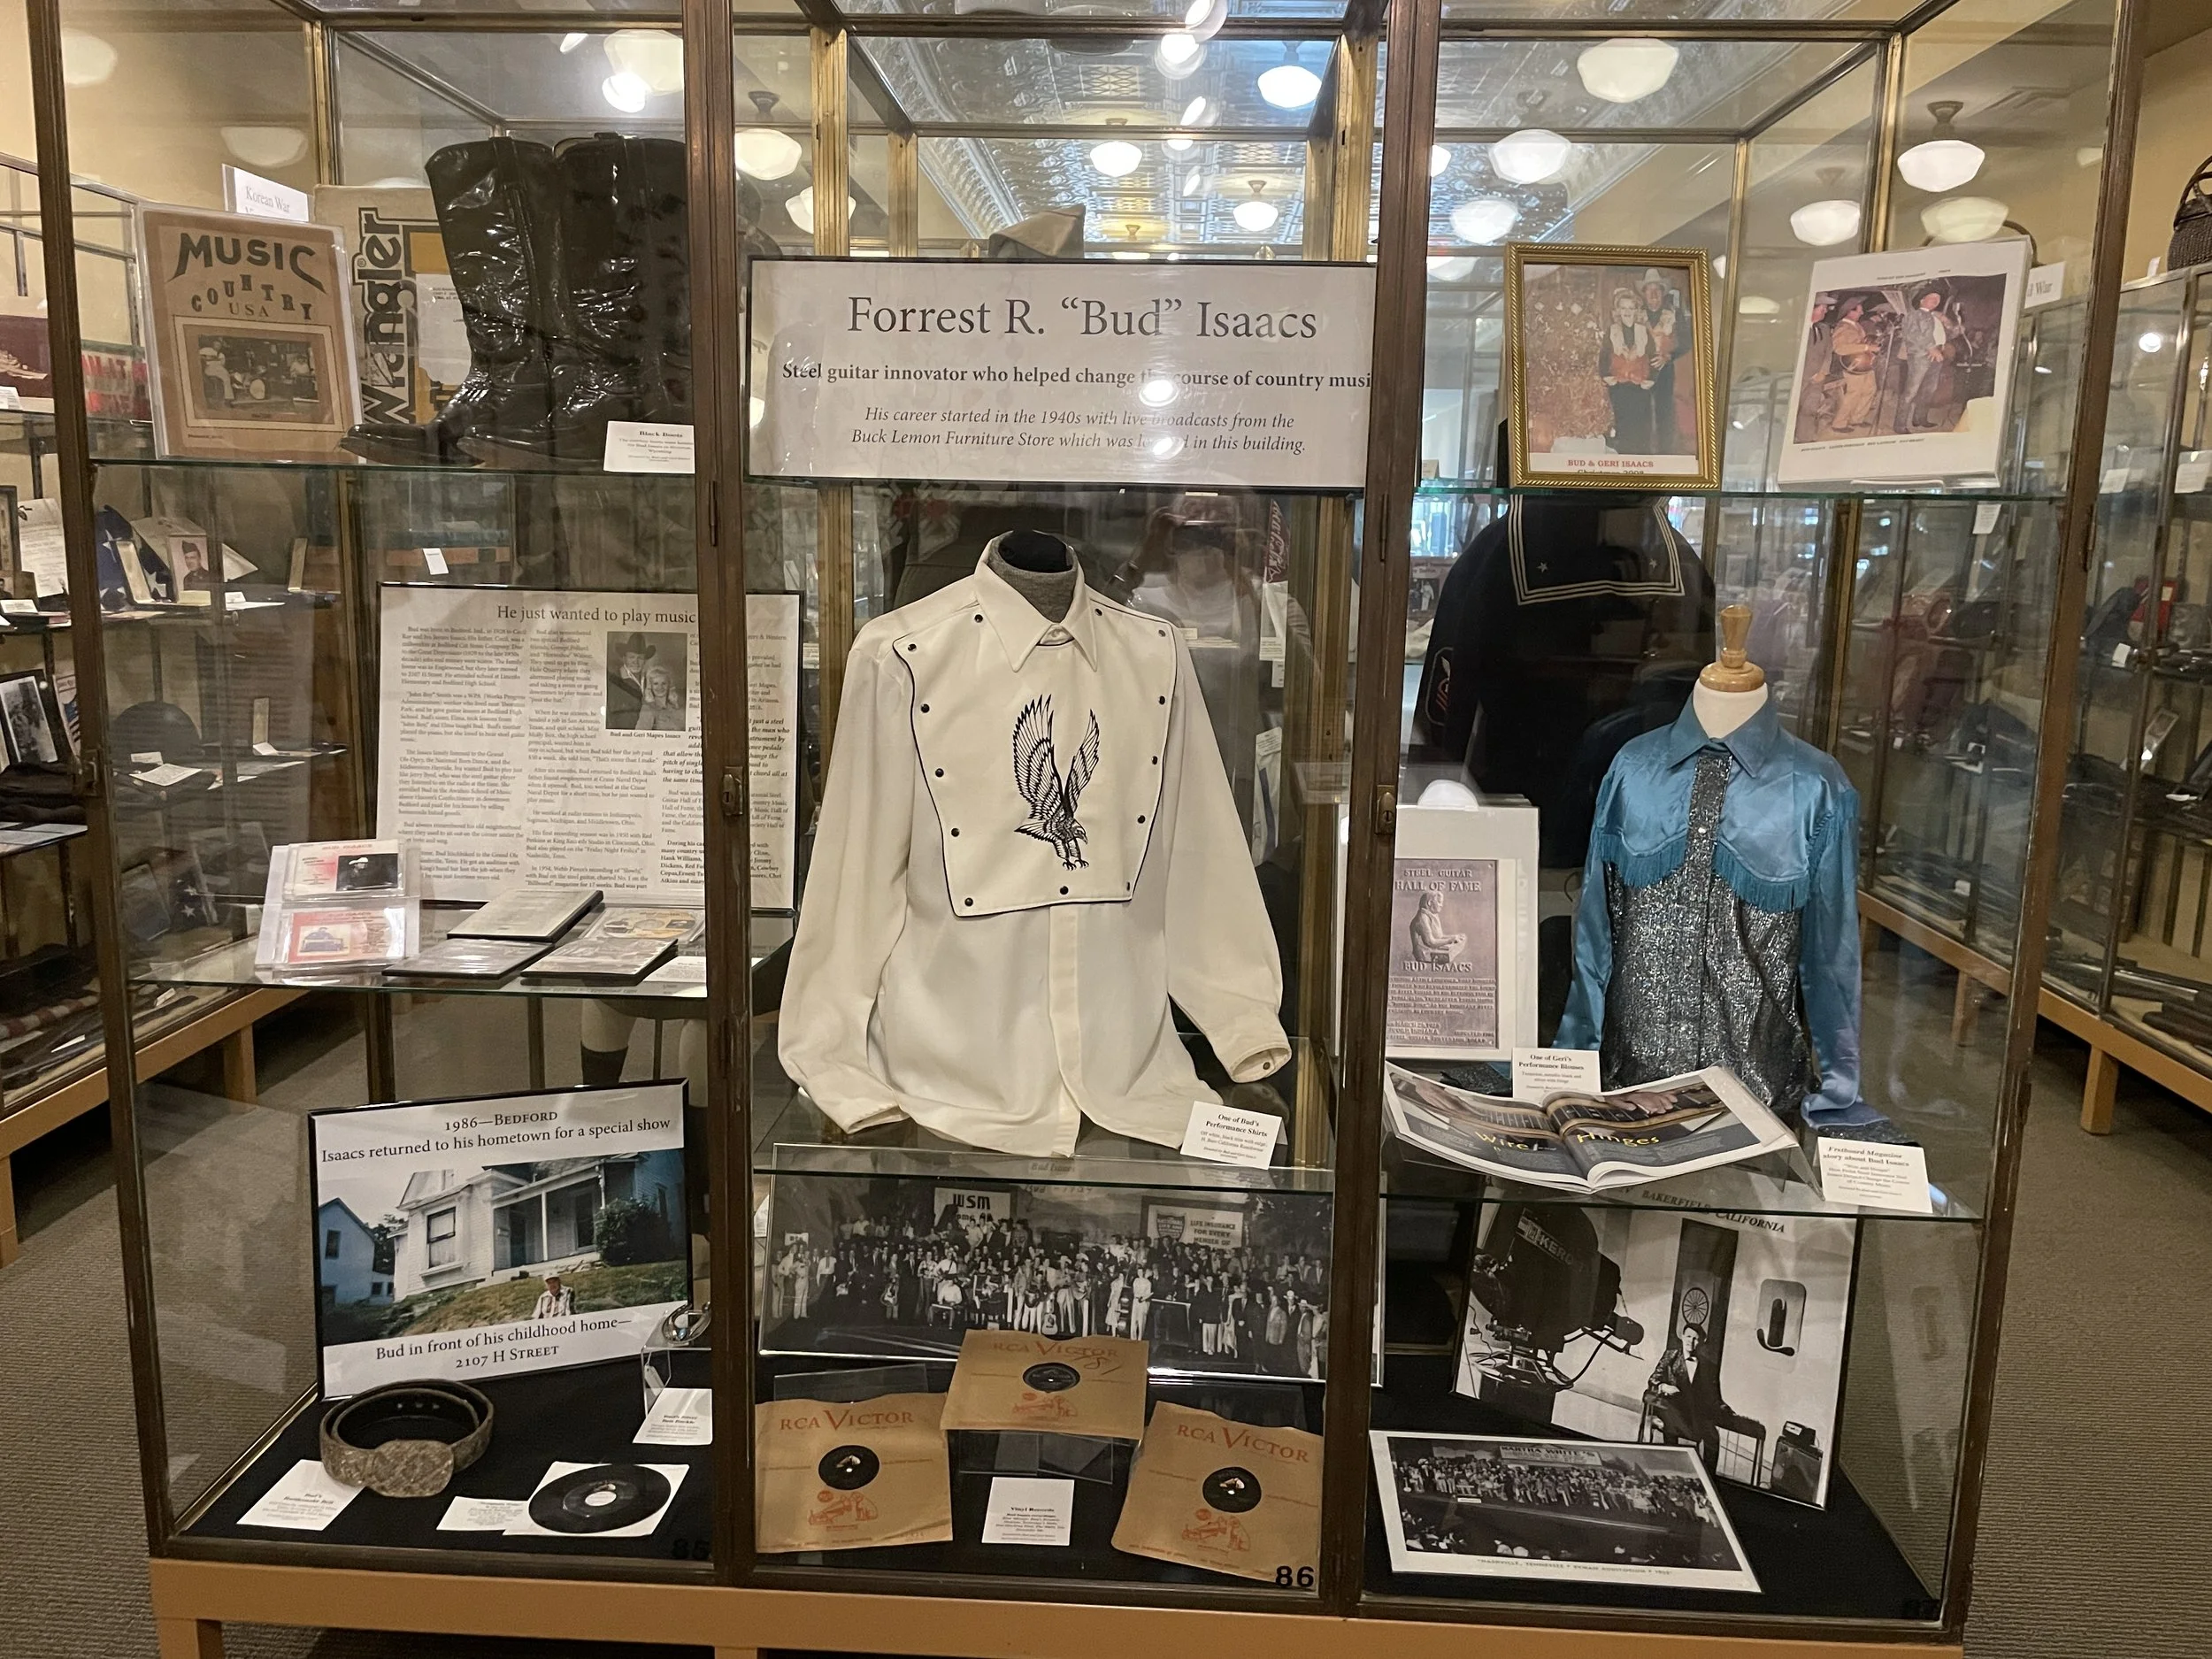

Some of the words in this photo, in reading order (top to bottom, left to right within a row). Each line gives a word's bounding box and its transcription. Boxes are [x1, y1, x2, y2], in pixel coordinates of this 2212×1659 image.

[245, 185, 274, 207] Korean
[275, 193, 290, 213] War
[167, 233, 326, 295] MUSIC
[191, 274, 312, 320] COUNTRY
[229, 302, 270, 318] USA
[847, 296, 991, 334] Forrest
[1005, 299, 1045, 334] R.
[1196, 302, 1317, 338] Isaacs
[782, 364, 822, 379] Steel
[827, 365, 879, 383] guitar
[884, 365, 968, 381] innovator
[972, 366, 1009, 381] who
[1013, 367, 1071, 387] helped
[1075, 369, 1135, 388] change
[1233, 371, 1253, 385] of
[1255, 373, 1325, 392] country
[1329, 373, 1371, 388] musi
[865, 407, 888, 421] His
[893, 411, 937, 422] career
[941, 409, 990, 423] started
[995, 411, 1009, 424] in
[1013, 410, 1036, 424] the
[1041, 411, 1081, 424] 1940s
[1086, 411, 1118, 425] with
[1123, 411, 1147, 426] live
[1229, 411, 1267, 432] from
[1272, 414, 1294, 428] the
[852, 429, 887, 443] Buck
[891, 430, 941, 444] Lemon
[946, 431, 1014, 446] Furniture
[1018, 432, 1055, 447] Store
[1059, 433, 1102, 447] which
[1106, 438, 1133, 449] was
[1194, 436, 1207, 449] in
[1212, 435, 1239, 450] this
[1242, 435, 1306, 455] building.
[497, 605, 518, 618] He
[520, 606, 545, 623] just
[549, 607, 599, 620] wanted
[604, 610, 618, 620] to
[622, 609, 651, 626] play
[655, 611, 695, 624] music
[1394, 881, 1426, 891] HALL
[1429, 881, 1445, 891] OF
[1448, 882, 1481, 892] FAME
[1402, 961, 1426, 972] BUD
[1432, 961, 1472, 972] ISAACS
[1206, 1120, 1247, 1133] Performance
[321, 1148, 365, 1163] Isaacs
[369, 1140, 431, 1158] returned
[435, 1139, 449, 1152] to
[453, 1135, 474, 1150] his
[477, 1130, 550, 1148] hometown
[555, 1125, 574, 1140] for
[578, 1127, 586, 1138] a
[588, 1120, 634, 1142] special
[637, 1117, 671, 1133] show
[1475, 1131, 1530, 1151] Wire
[1577, 1132, 1660, 1148] Hinges
[376, 1343, 404, 1362] Bud
[409, 1343, 423, 1356] in
[427, 1338, 463, 1353] front
[466, 1333, 482, 1348] of
[484, 1331, 504, 1346] his
[507, 1321, 576, 1341] childhood
[456, 1355, 488, 1369] 2107
[493, 1349, 505, 1363] H
[780, 1417, 821, 1431] RCA
[823, 1409, 915, 1431] VICTOR
[1177, 1424, 1216, 1444] RCA
[1222, 1426, 1310, 1463] VICTOR
[1275, 1565, 1315, 1588] 86
